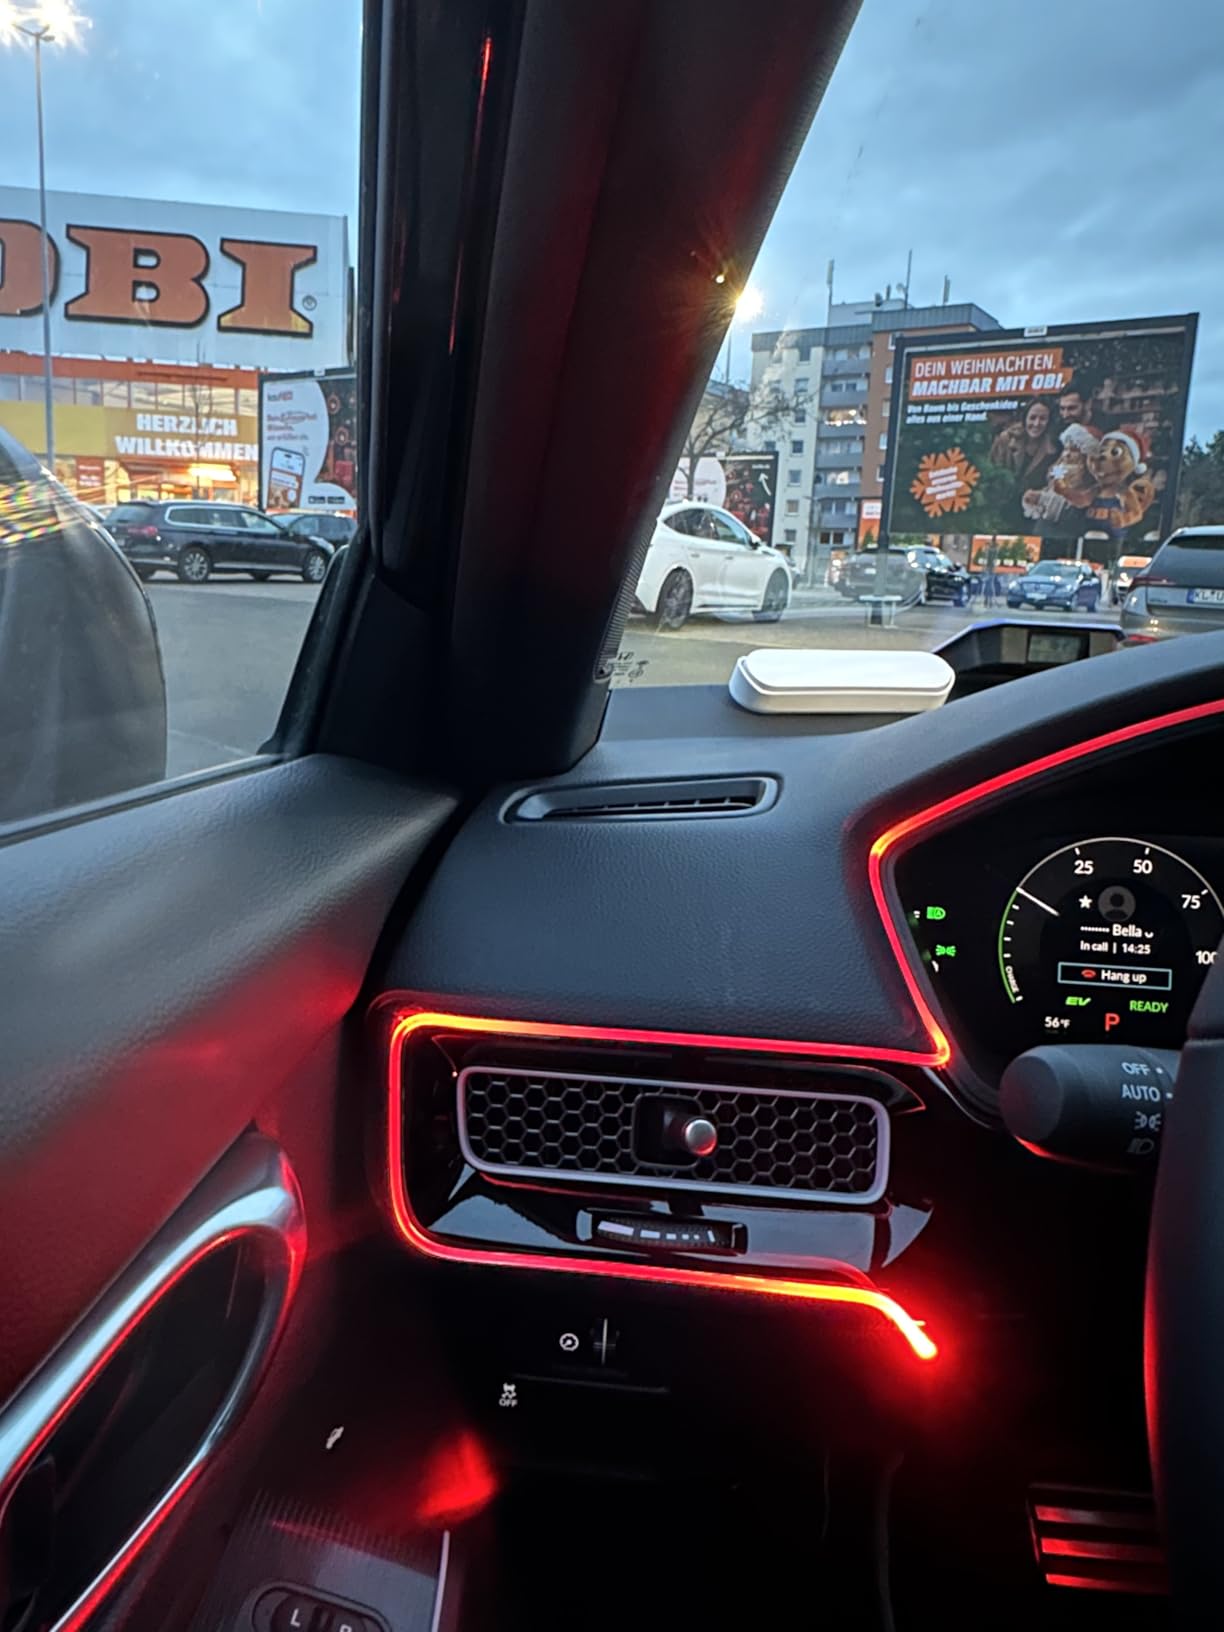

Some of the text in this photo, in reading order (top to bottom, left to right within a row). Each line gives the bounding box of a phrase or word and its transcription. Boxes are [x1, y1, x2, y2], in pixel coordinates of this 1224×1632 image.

[915, 354, 1056, 378] DEIN WEIHNACHTEN.
[911, 372, 1066, 396] MACHBAR MIT OBI.
[136, 413, 238, 436] HERZLICH
[115, 435, 258, 460] WILLKOMMEN
[1073, 859, 1095, 875] 25
[1132, 859, 1153, 875] 50
[1181, 894, 1201, 910] 75
[1112, 923, 1143, 938] Bella
[1080, 940, 1151, 955] In call 14:25
[1101, 969, 1147, 985] Hang up
[1129, 1000, 1169, 1013] READY
[1104, 1012, 1121, 1032] P
[1121, 1062, 1150, 1076] OFF
[1121, 1083, 1161, 1102] AUTO
[499, 1398, 517, 1407] OFF
[290, 1608, 301, 1628] L
